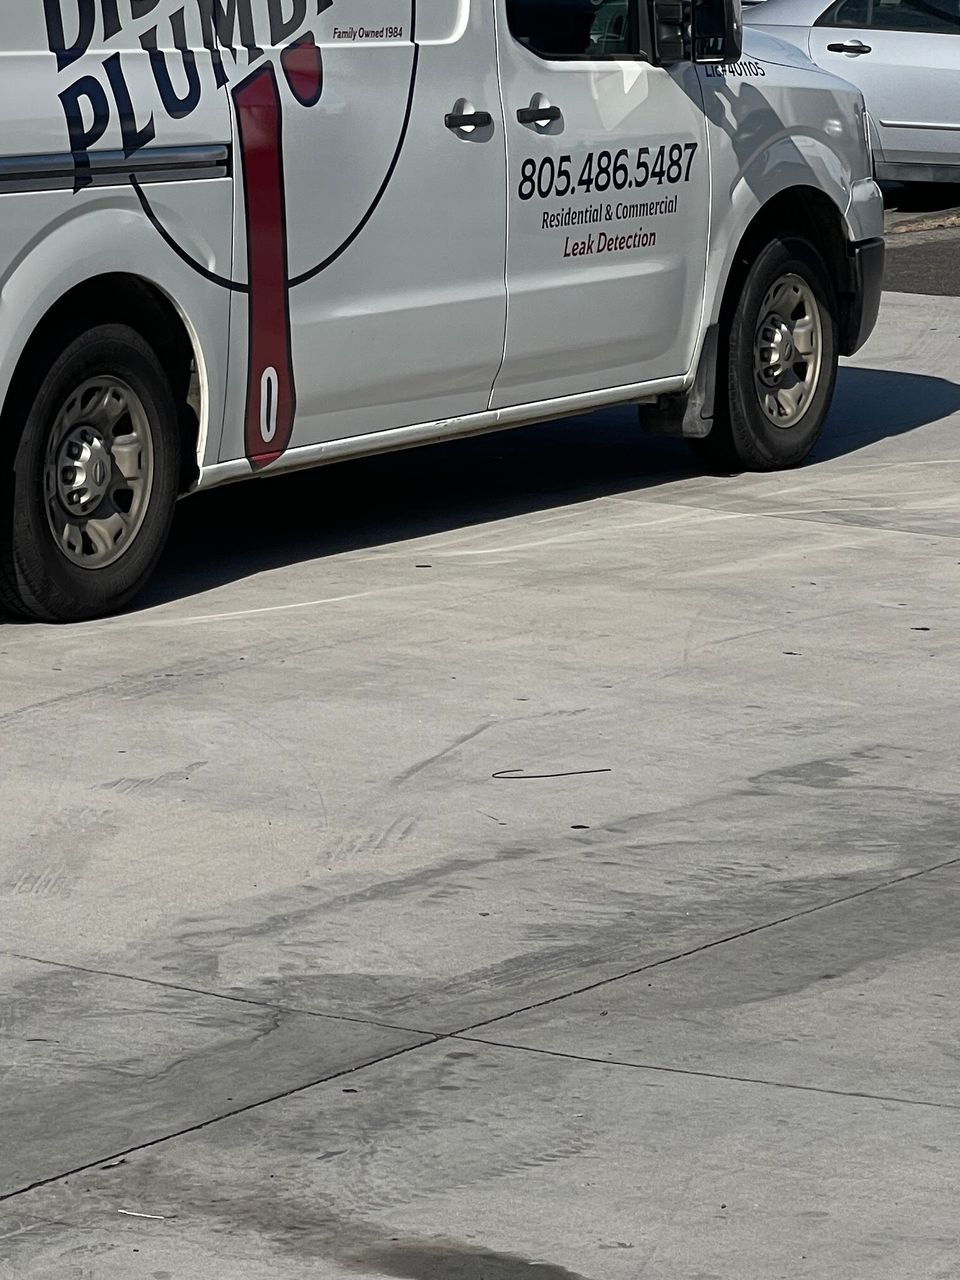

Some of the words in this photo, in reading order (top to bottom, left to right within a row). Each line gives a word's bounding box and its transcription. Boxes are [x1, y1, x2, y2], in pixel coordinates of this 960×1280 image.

[333, 27, 357, 40] Family
[358, 27, 384, 38] Owned
[385, 27, 403, 38] 1984
[518, 142, 698, 201] 805.486.5487
[542, 204, 602, 229] Residential
[605, 205, 613, 221] &
[615, 195, 678, 220] Commercial
[563, 233, 594, 258] Leak
[596, 228, 656, 254] Detection
